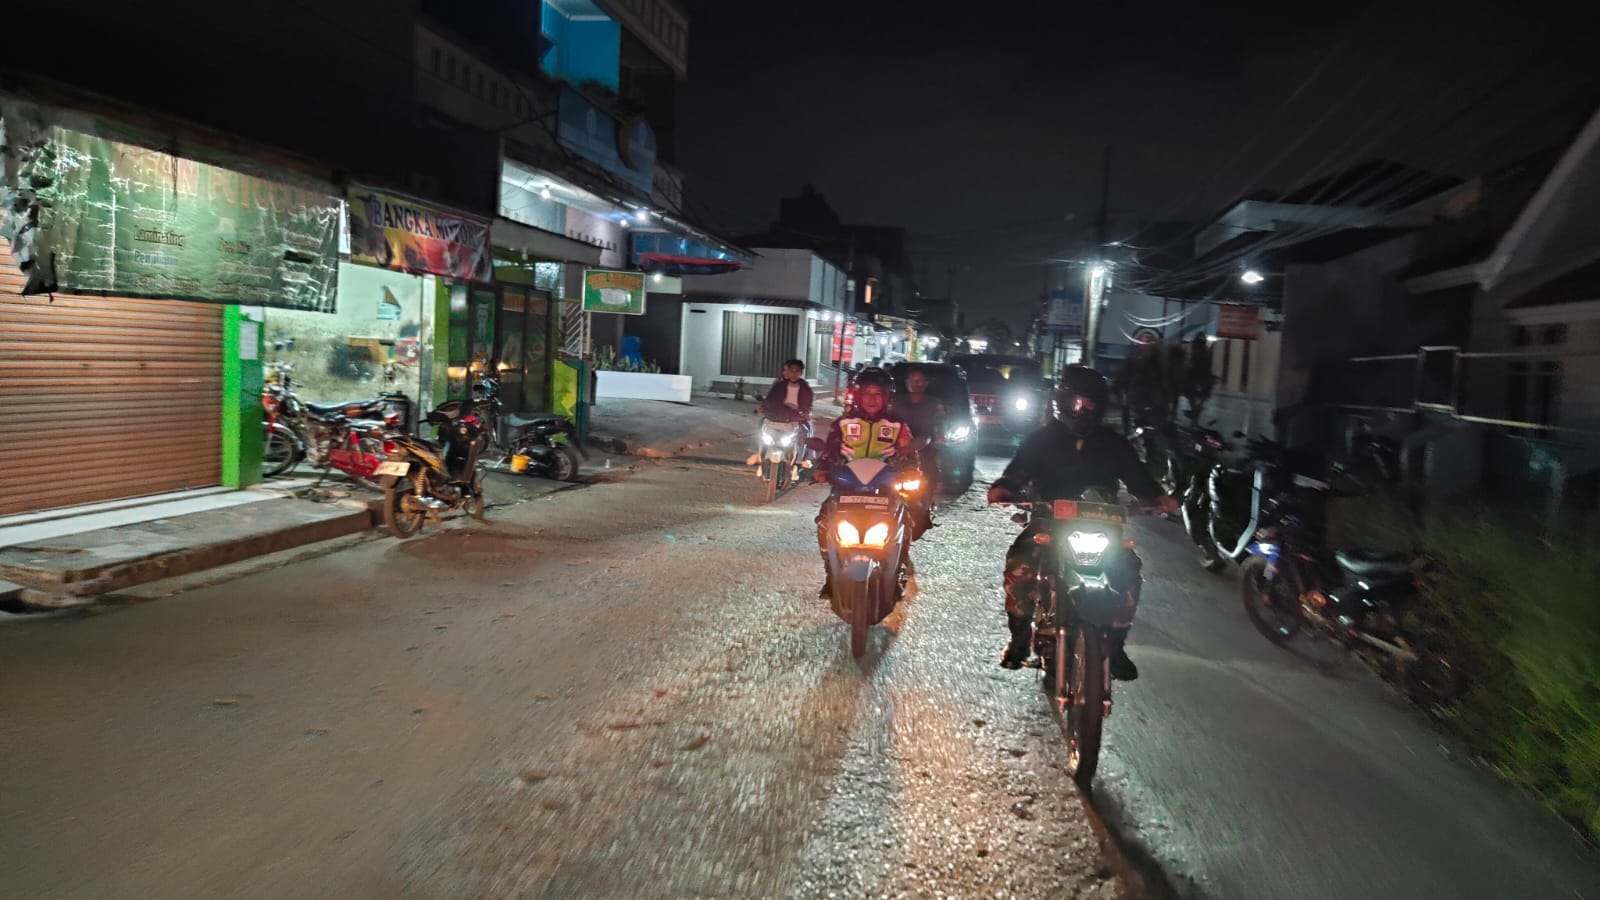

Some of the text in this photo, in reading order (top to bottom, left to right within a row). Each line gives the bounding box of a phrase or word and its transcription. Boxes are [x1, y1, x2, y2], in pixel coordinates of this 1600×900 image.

[134, 225, 185, 250] Laminating
[373, 198, 478, 247] BANGKA MOTOR
